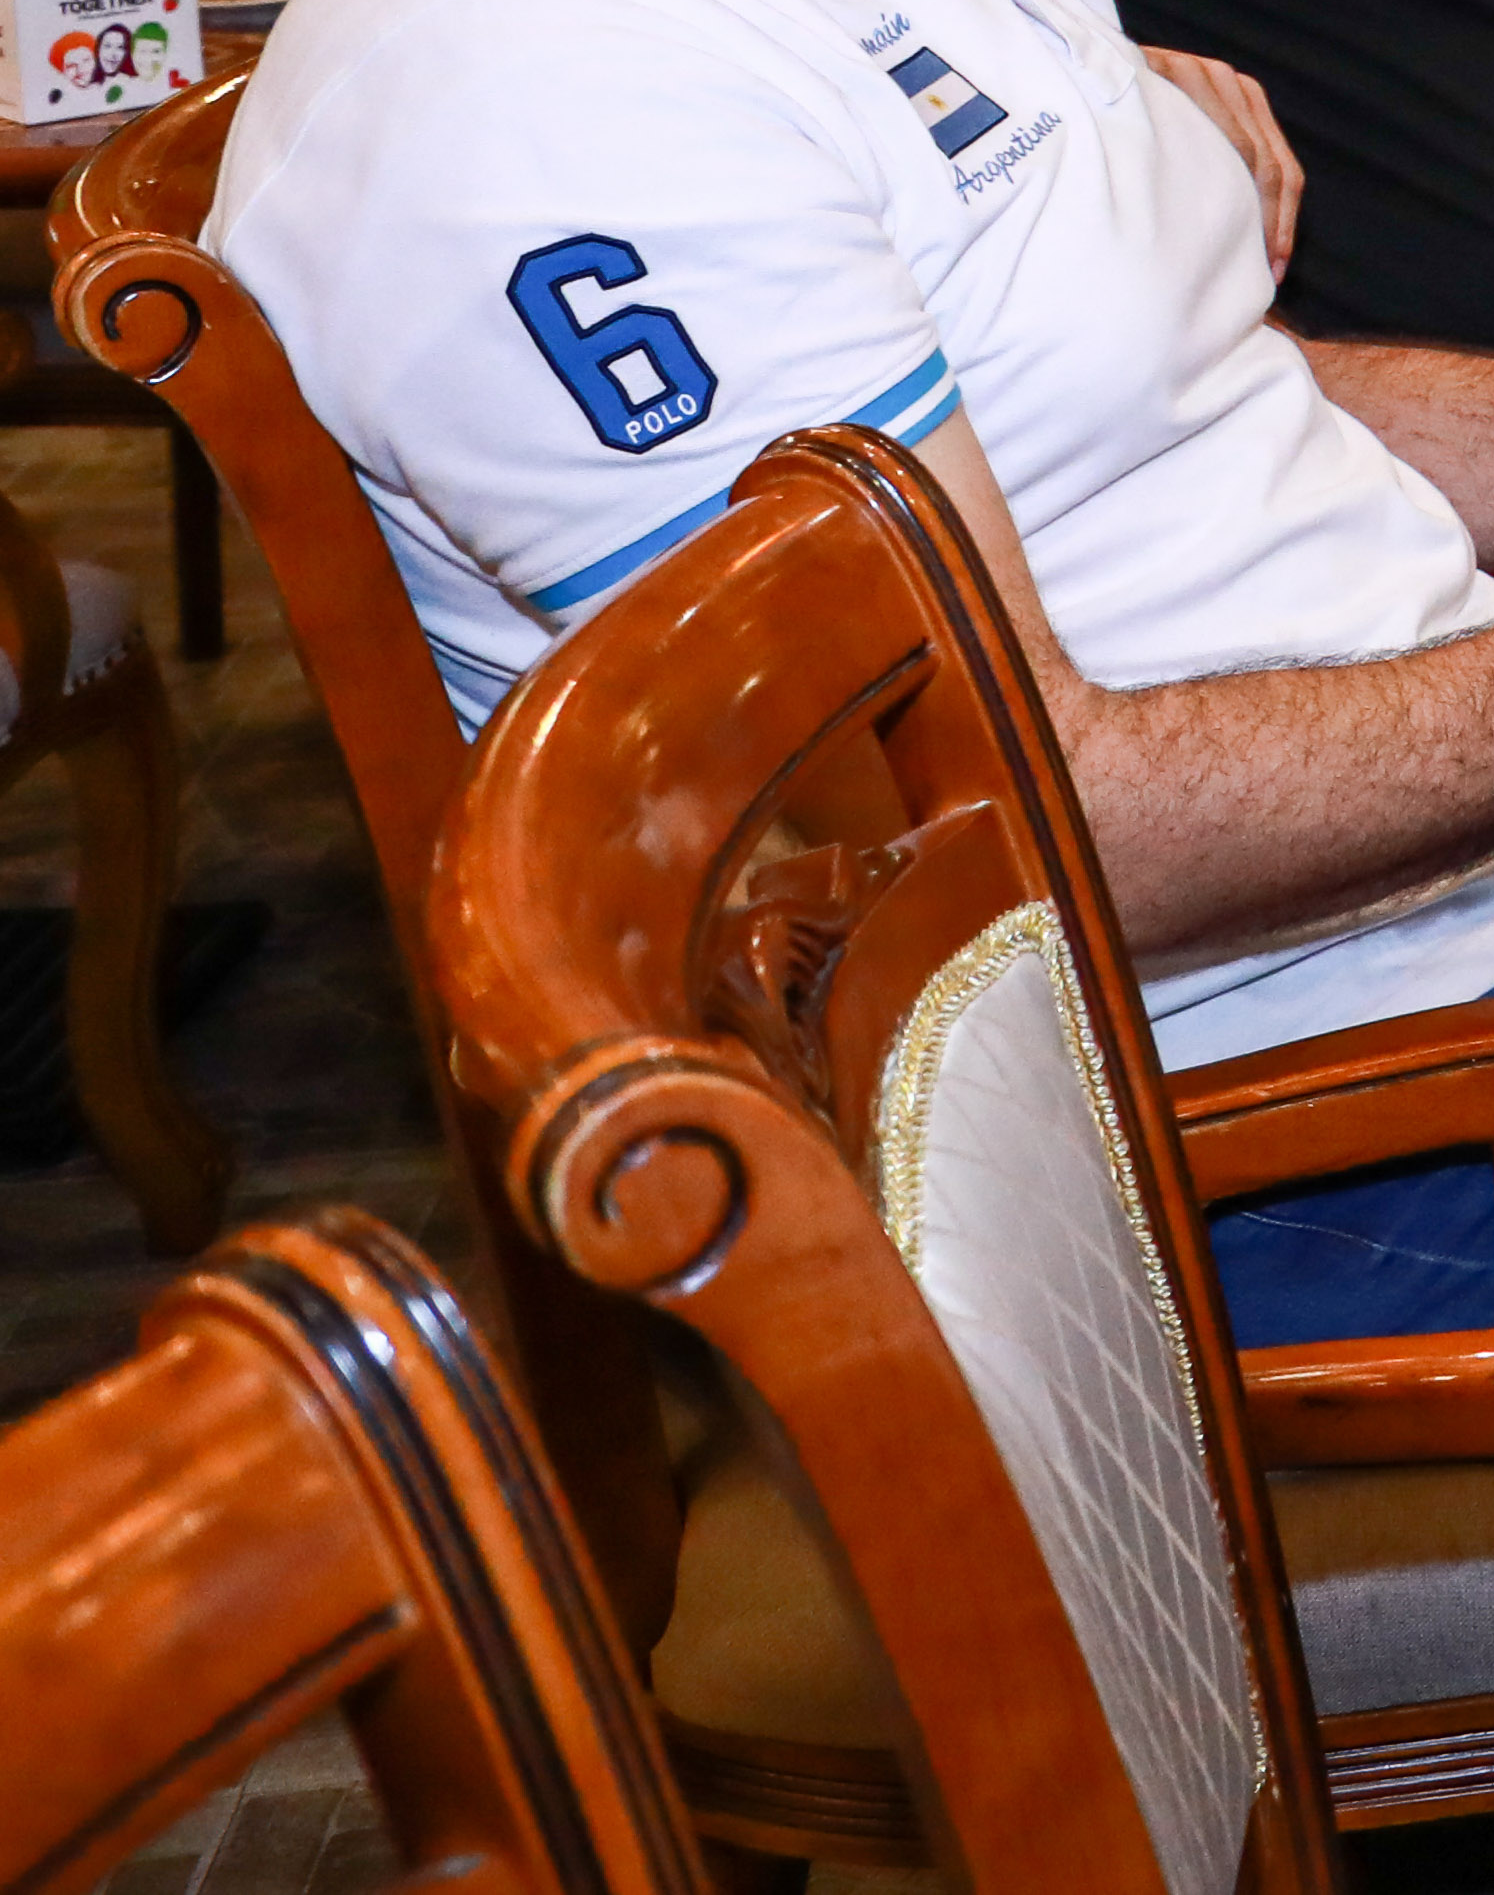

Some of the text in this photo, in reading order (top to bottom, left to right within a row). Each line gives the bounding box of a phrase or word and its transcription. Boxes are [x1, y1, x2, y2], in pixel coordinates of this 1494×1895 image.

[953, 111, 1063, 205] Argentina
[505, 232, 719, 455] 6
[625, 393, 697, 444] POLO
